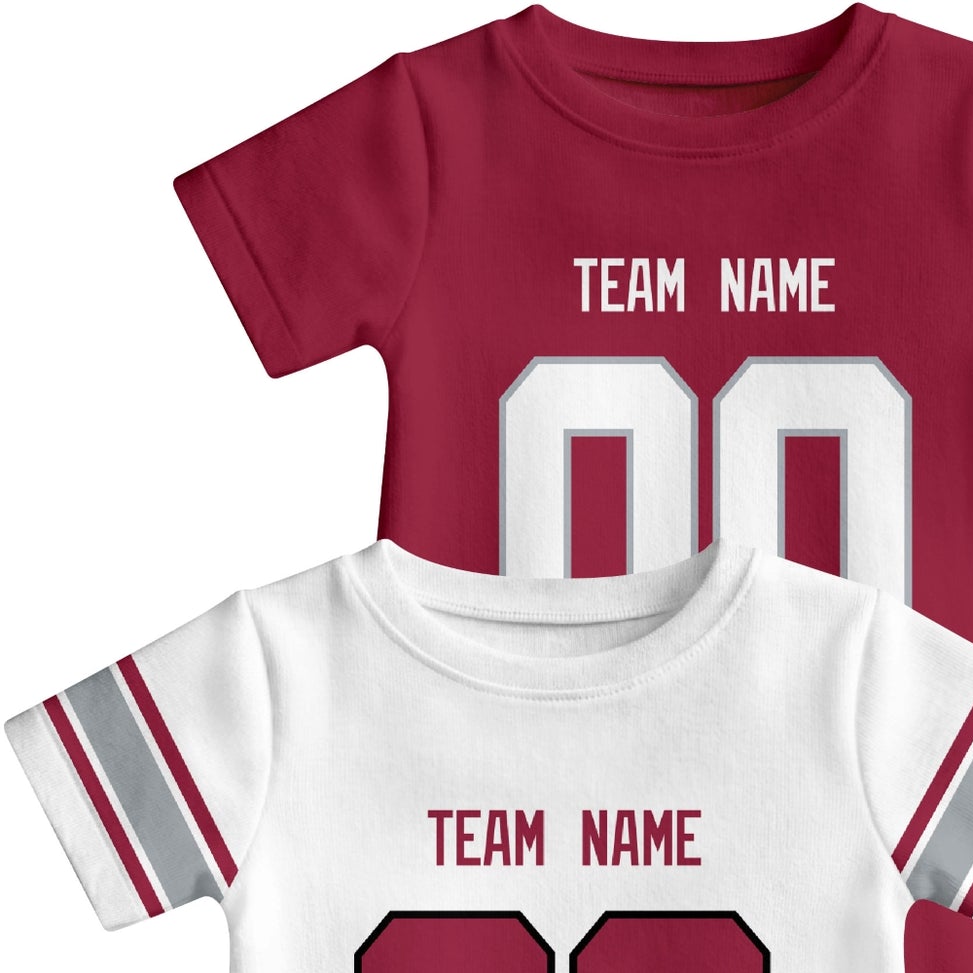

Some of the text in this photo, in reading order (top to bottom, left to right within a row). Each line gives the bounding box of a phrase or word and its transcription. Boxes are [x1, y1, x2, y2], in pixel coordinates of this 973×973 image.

[573, 257, 836, 313] TEAM NAME
[427, 809, 702, 867] TEAM NAME
